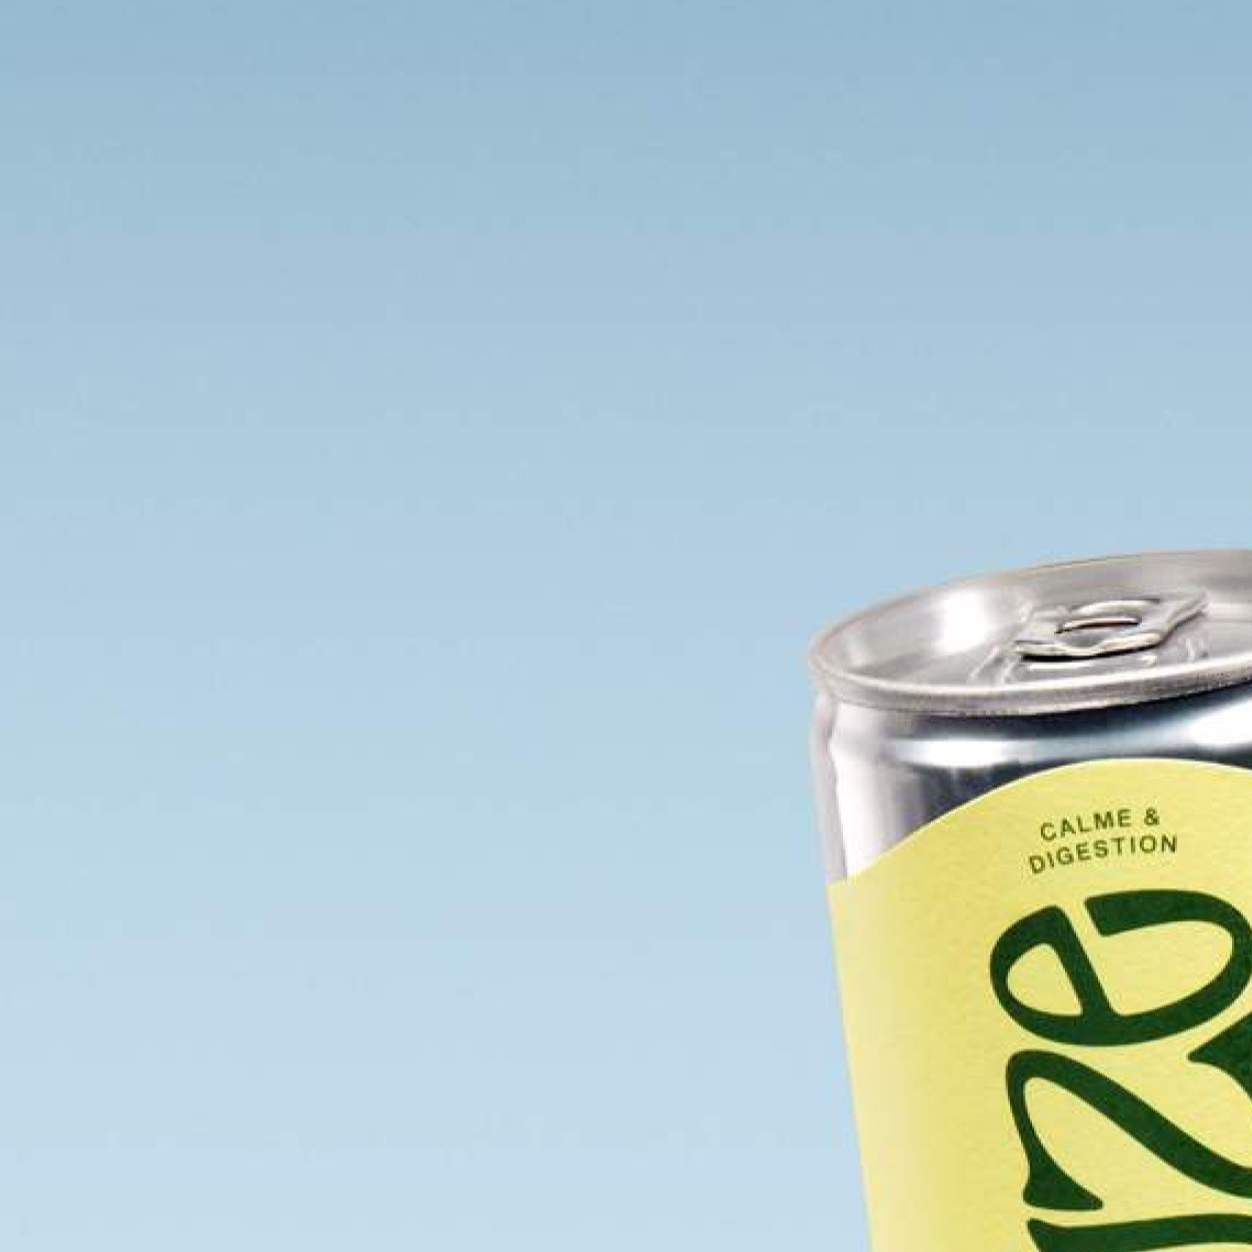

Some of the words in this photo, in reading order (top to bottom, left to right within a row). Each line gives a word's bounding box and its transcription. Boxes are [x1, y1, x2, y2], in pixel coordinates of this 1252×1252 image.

[1040, 808, 1132, 842] CALME
[1143, 806, 1161, 826] &
[1029, 834, 1178, 875] DIGESTION
